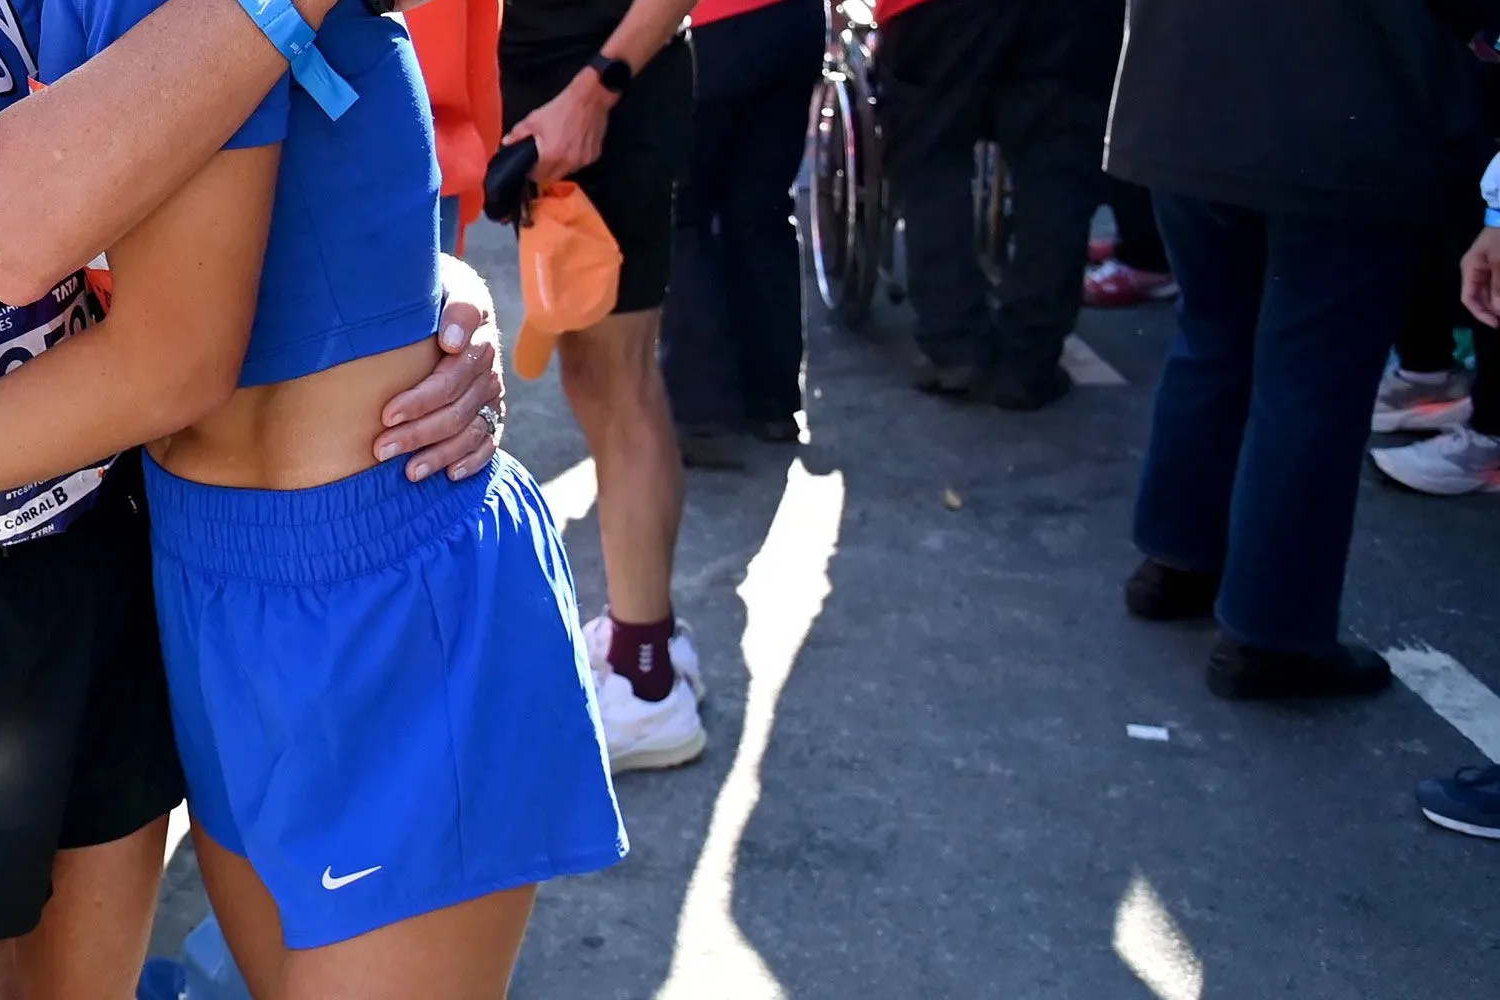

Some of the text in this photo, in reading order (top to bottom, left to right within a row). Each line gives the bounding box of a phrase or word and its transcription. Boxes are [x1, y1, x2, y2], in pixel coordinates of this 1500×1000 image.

[51, 275, 79, 303] TATA
[3, 498, 55, 531] CORRAL
[51, 485, 69, 507] B
